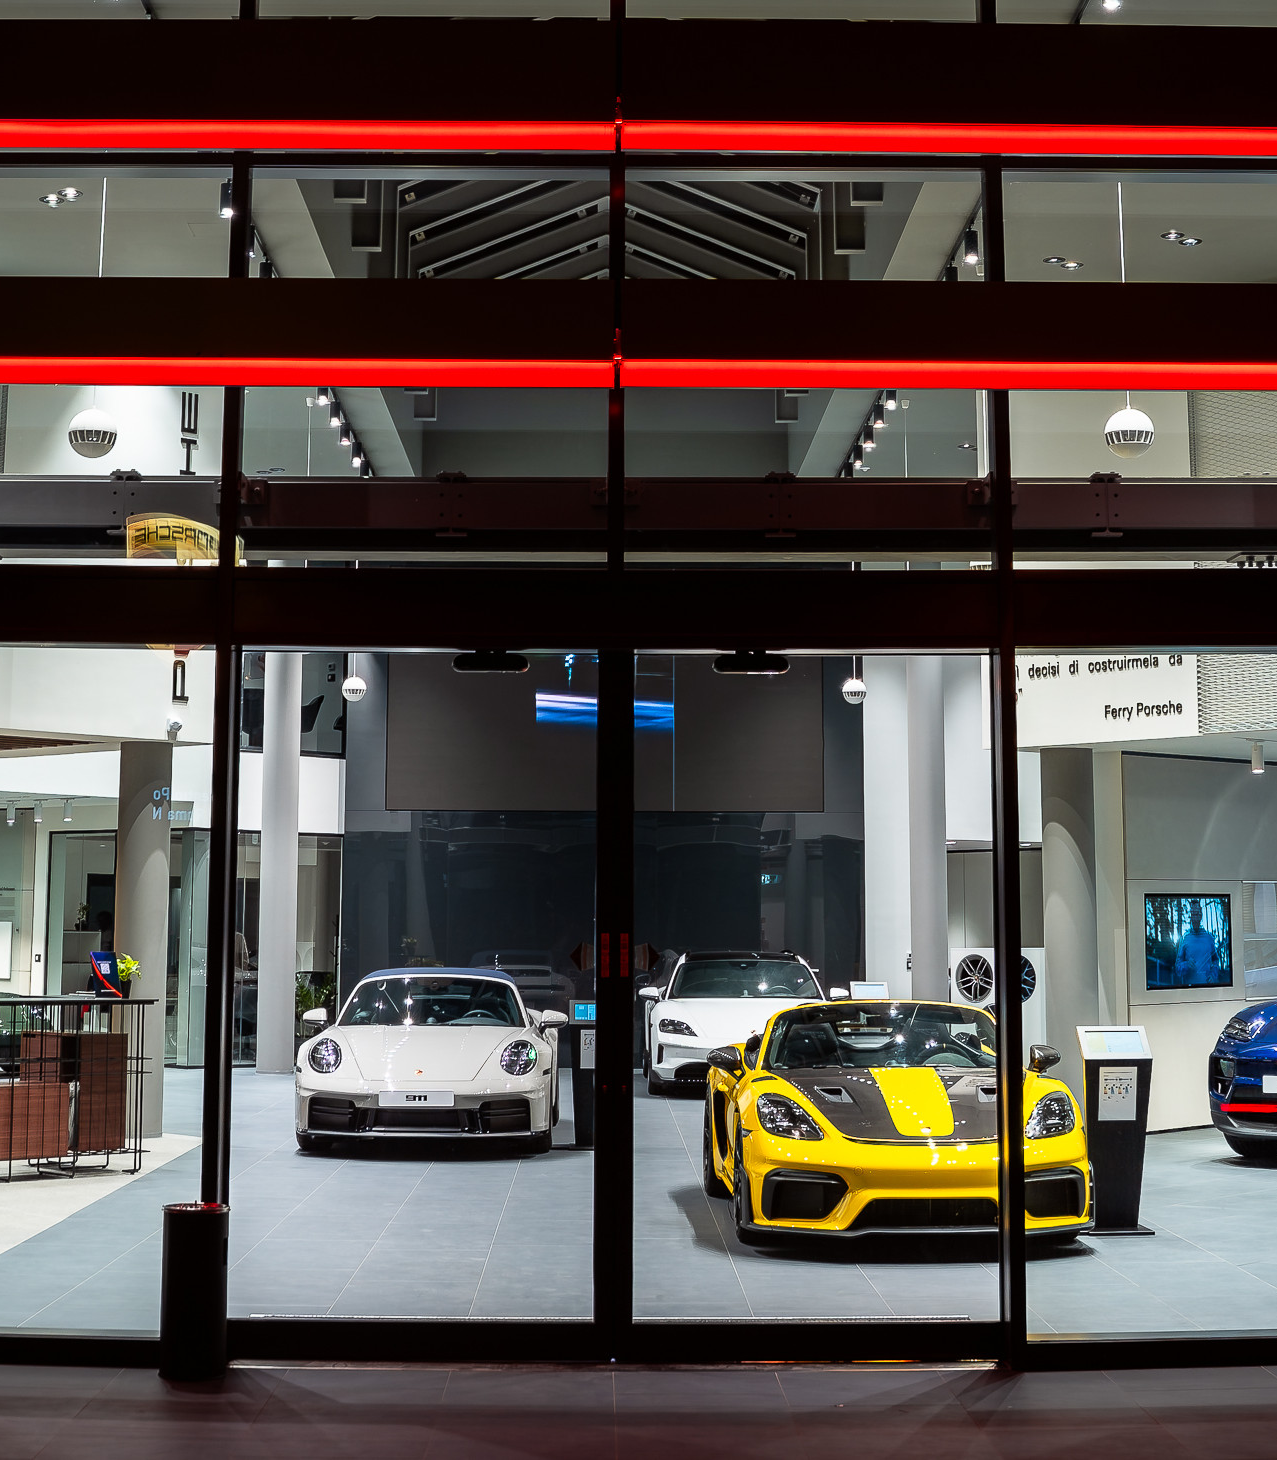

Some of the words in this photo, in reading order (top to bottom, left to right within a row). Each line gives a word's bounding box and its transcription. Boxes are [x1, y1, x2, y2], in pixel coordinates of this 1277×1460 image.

[1069, 660, 1079, 676] di
[1088, 655, 1159, 674] costruirmela
[1169, 655, 1183, 666] da
[1104, 704, 1133, 722] Ferry
[1137, 701, 1183, 718] Porsche
[405, 1094, 428, 1102] 911
